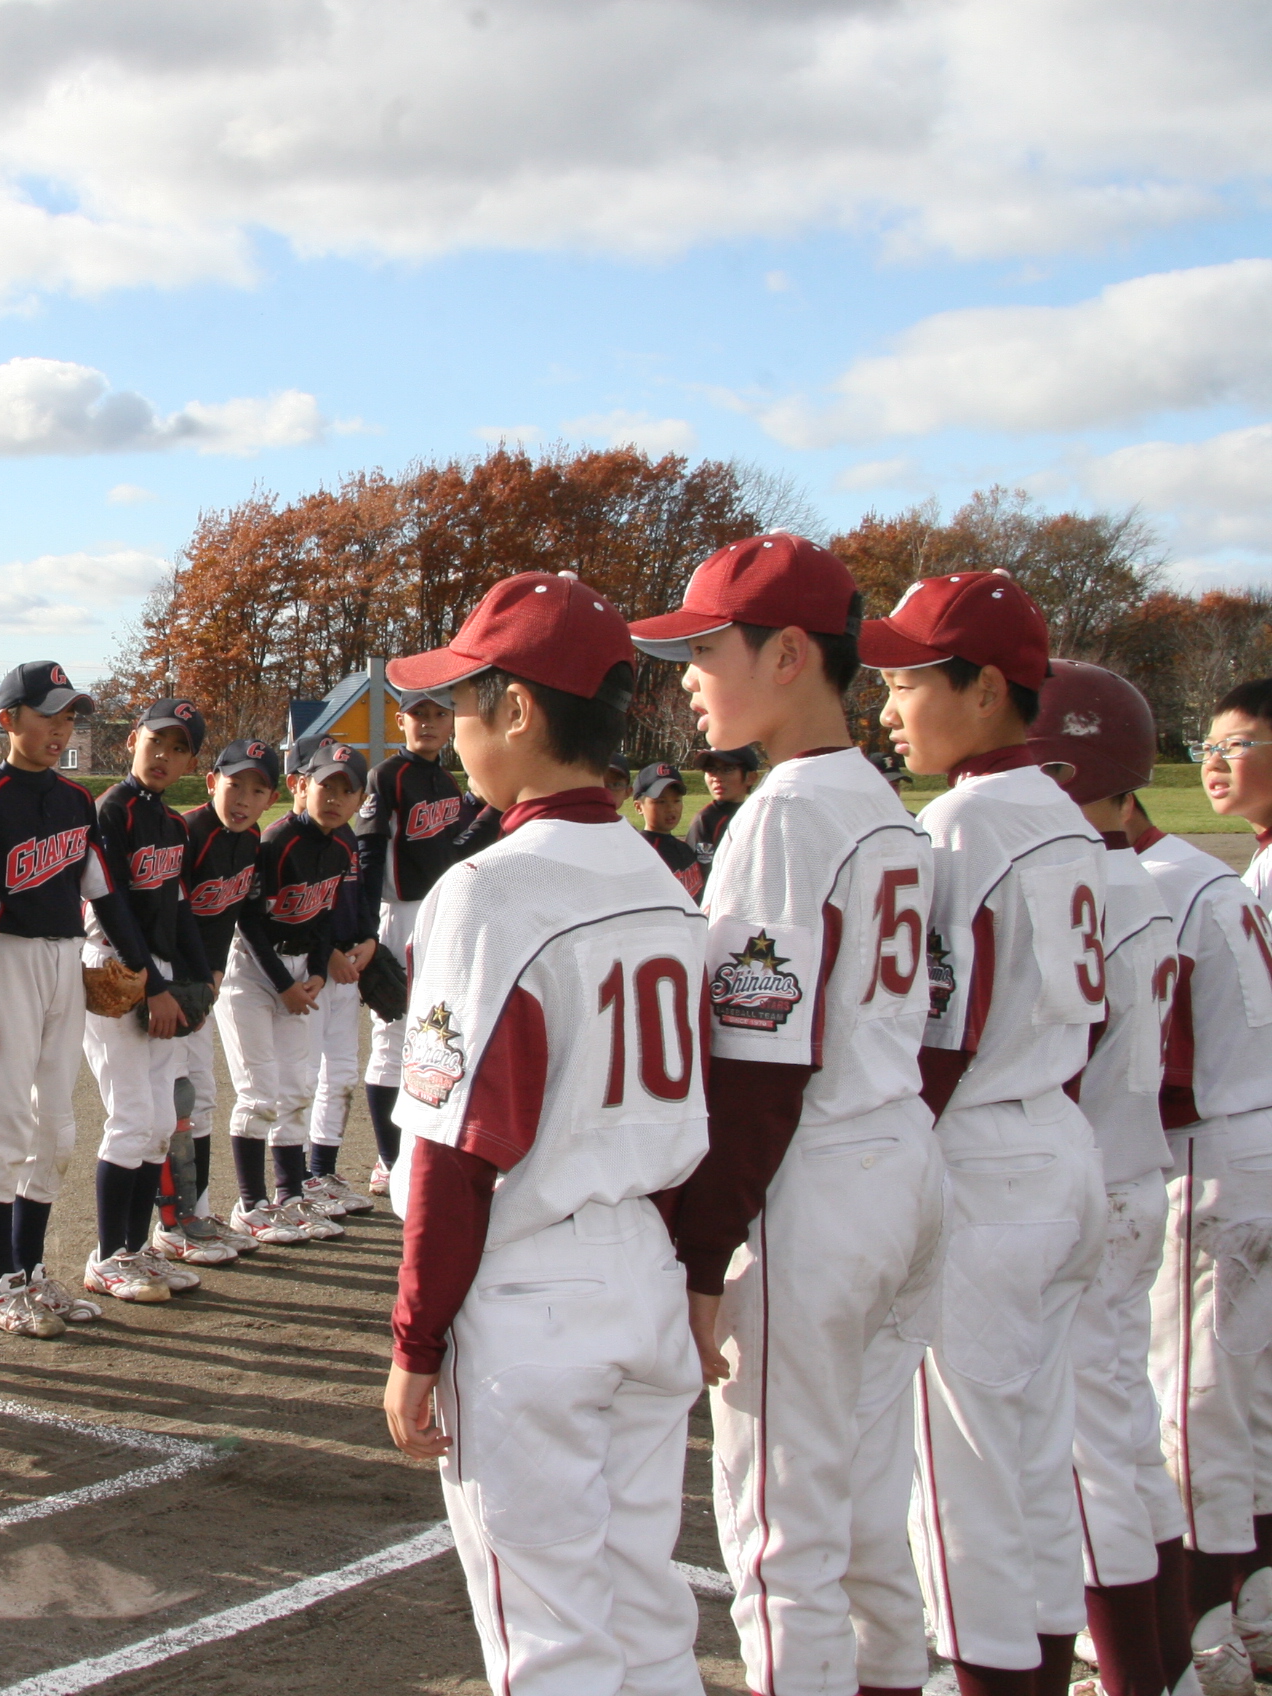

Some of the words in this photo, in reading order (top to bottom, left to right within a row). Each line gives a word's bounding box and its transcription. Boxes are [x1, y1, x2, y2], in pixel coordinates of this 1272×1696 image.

[51, 664, 68, 686] G
[174, 703, 196, 721] G
[246, 742, 266, 758] G
[333, 746, 352, 762] G
[656, 763, 671, 776] G
[5, 825, 91, 889] GIANTS
[859, 866, 919, 1005] 15
[1070, 879, 1106, 1005] 3
[1239, 903, 1272, 990] 1
[710, 965, 798, 1000] Shinano
[597, 953, 693, 1109] 10
